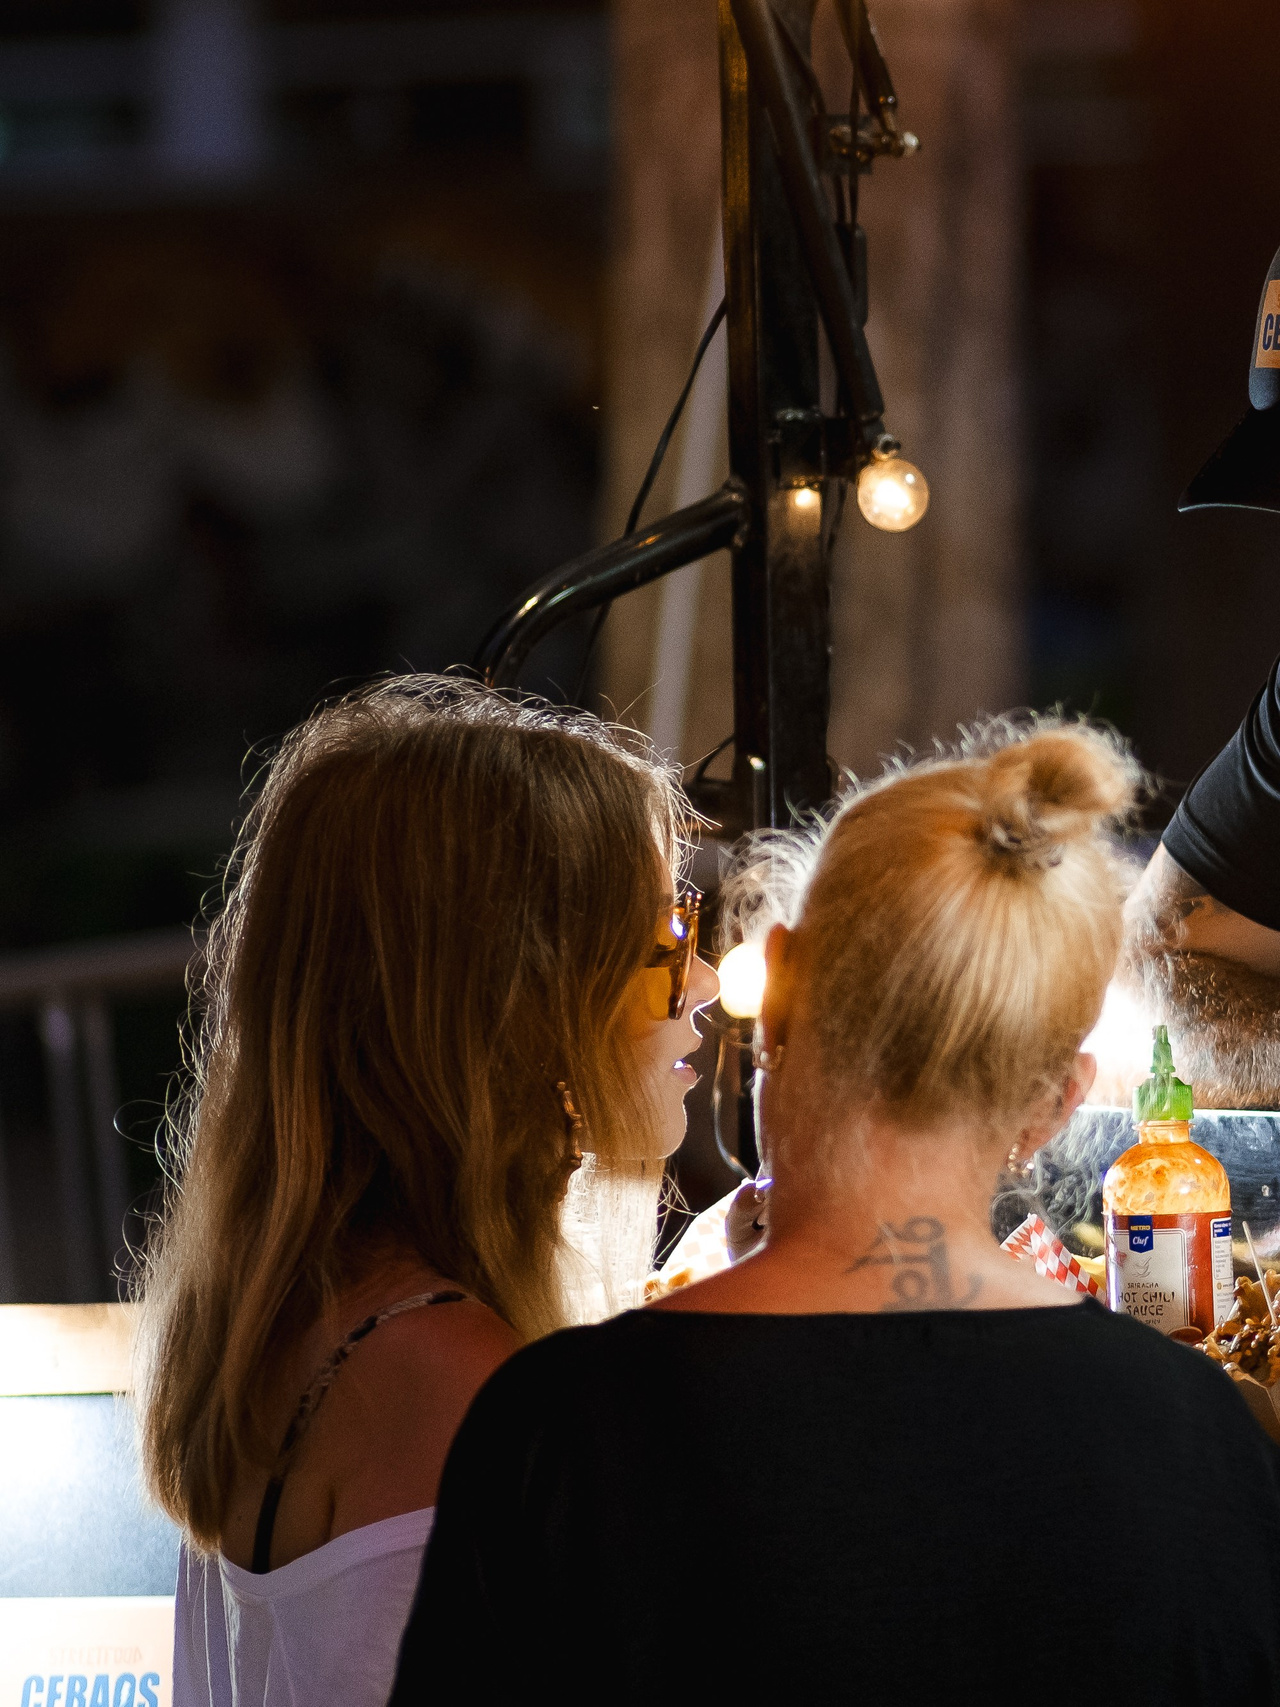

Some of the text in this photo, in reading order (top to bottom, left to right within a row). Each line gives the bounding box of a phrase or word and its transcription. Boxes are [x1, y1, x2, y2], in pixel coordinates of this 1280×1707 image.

[1118, 1291, 1175, 1303] HOT CHILI
[1126, 1304, 1164, 1316] SAUCE
[20, 1672, 161, 1707] CEBAOS
